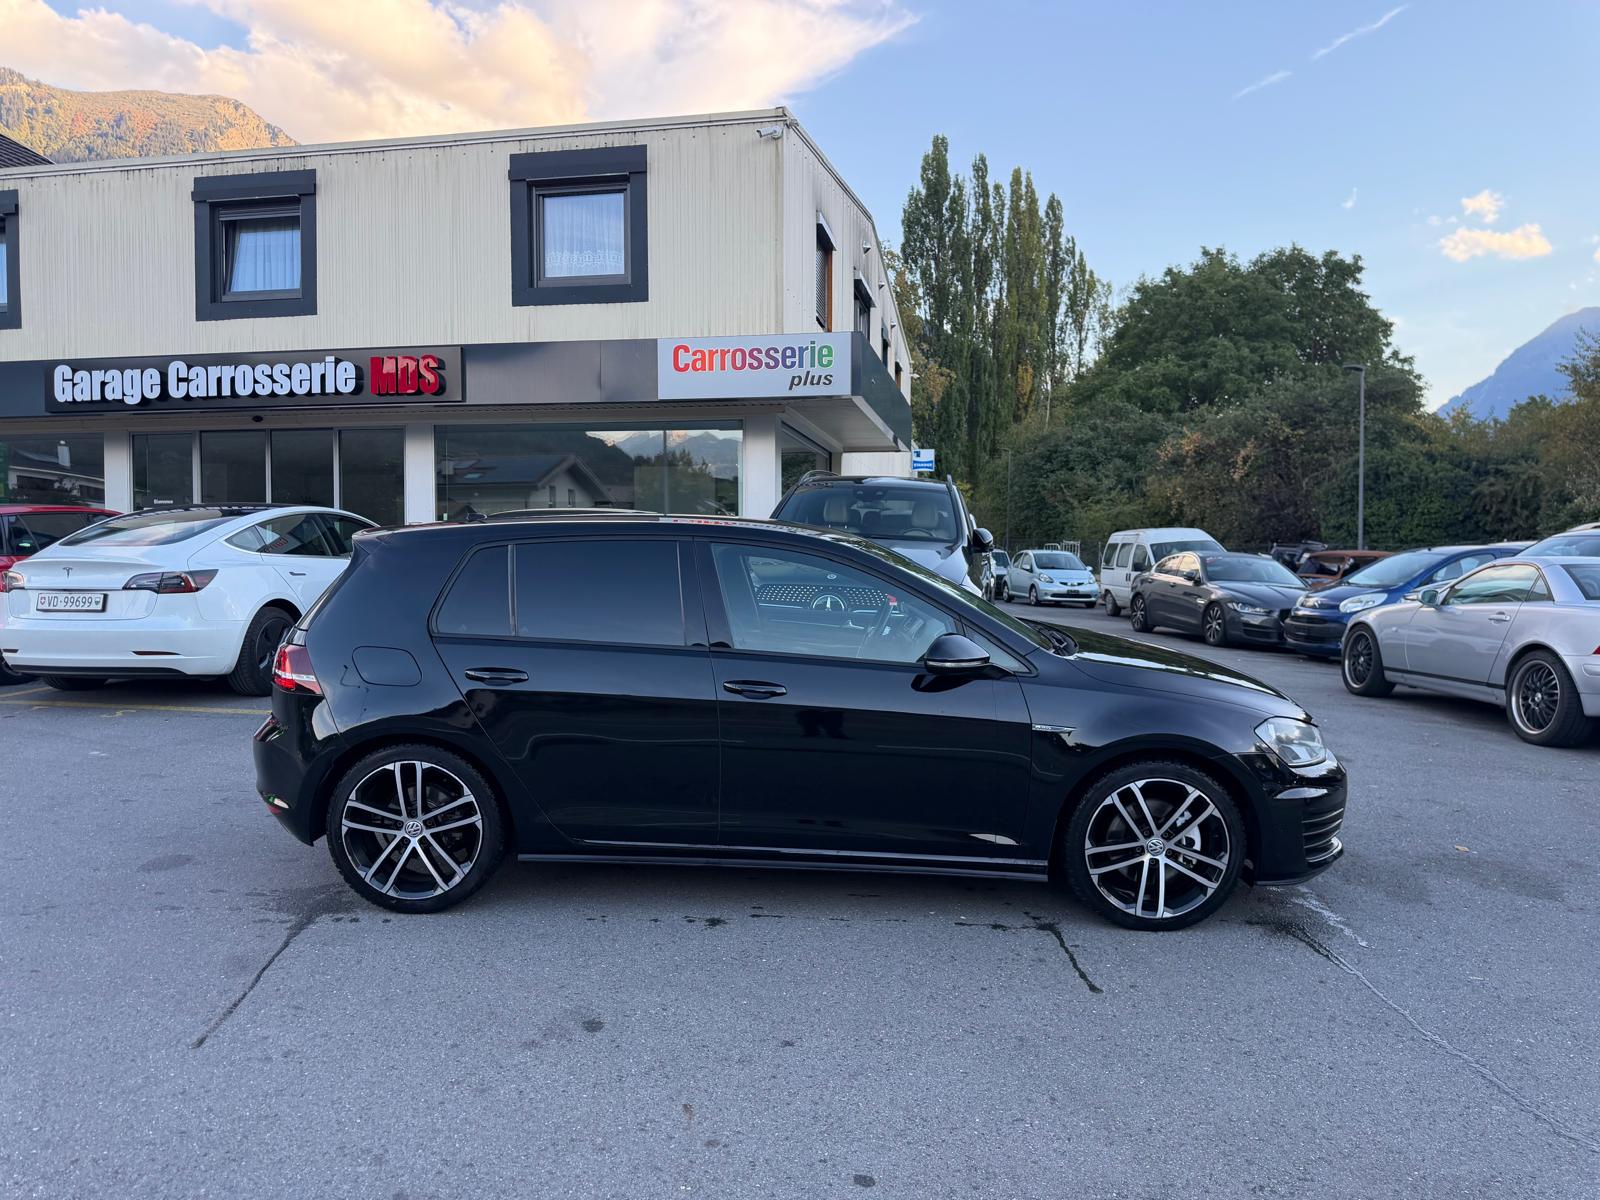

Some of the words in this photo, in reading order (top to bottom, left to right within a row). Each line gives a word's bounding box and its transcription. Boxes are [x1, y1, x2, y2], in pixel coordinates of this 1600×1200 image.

[673, 340, 834, 373] Carrosserie
[54, 364, 160, 405] Garage
[168, 356, 356, 398] Carrosserie
[370, 354, 440, 394] MDS
[788, 370, 834, 391] plus
